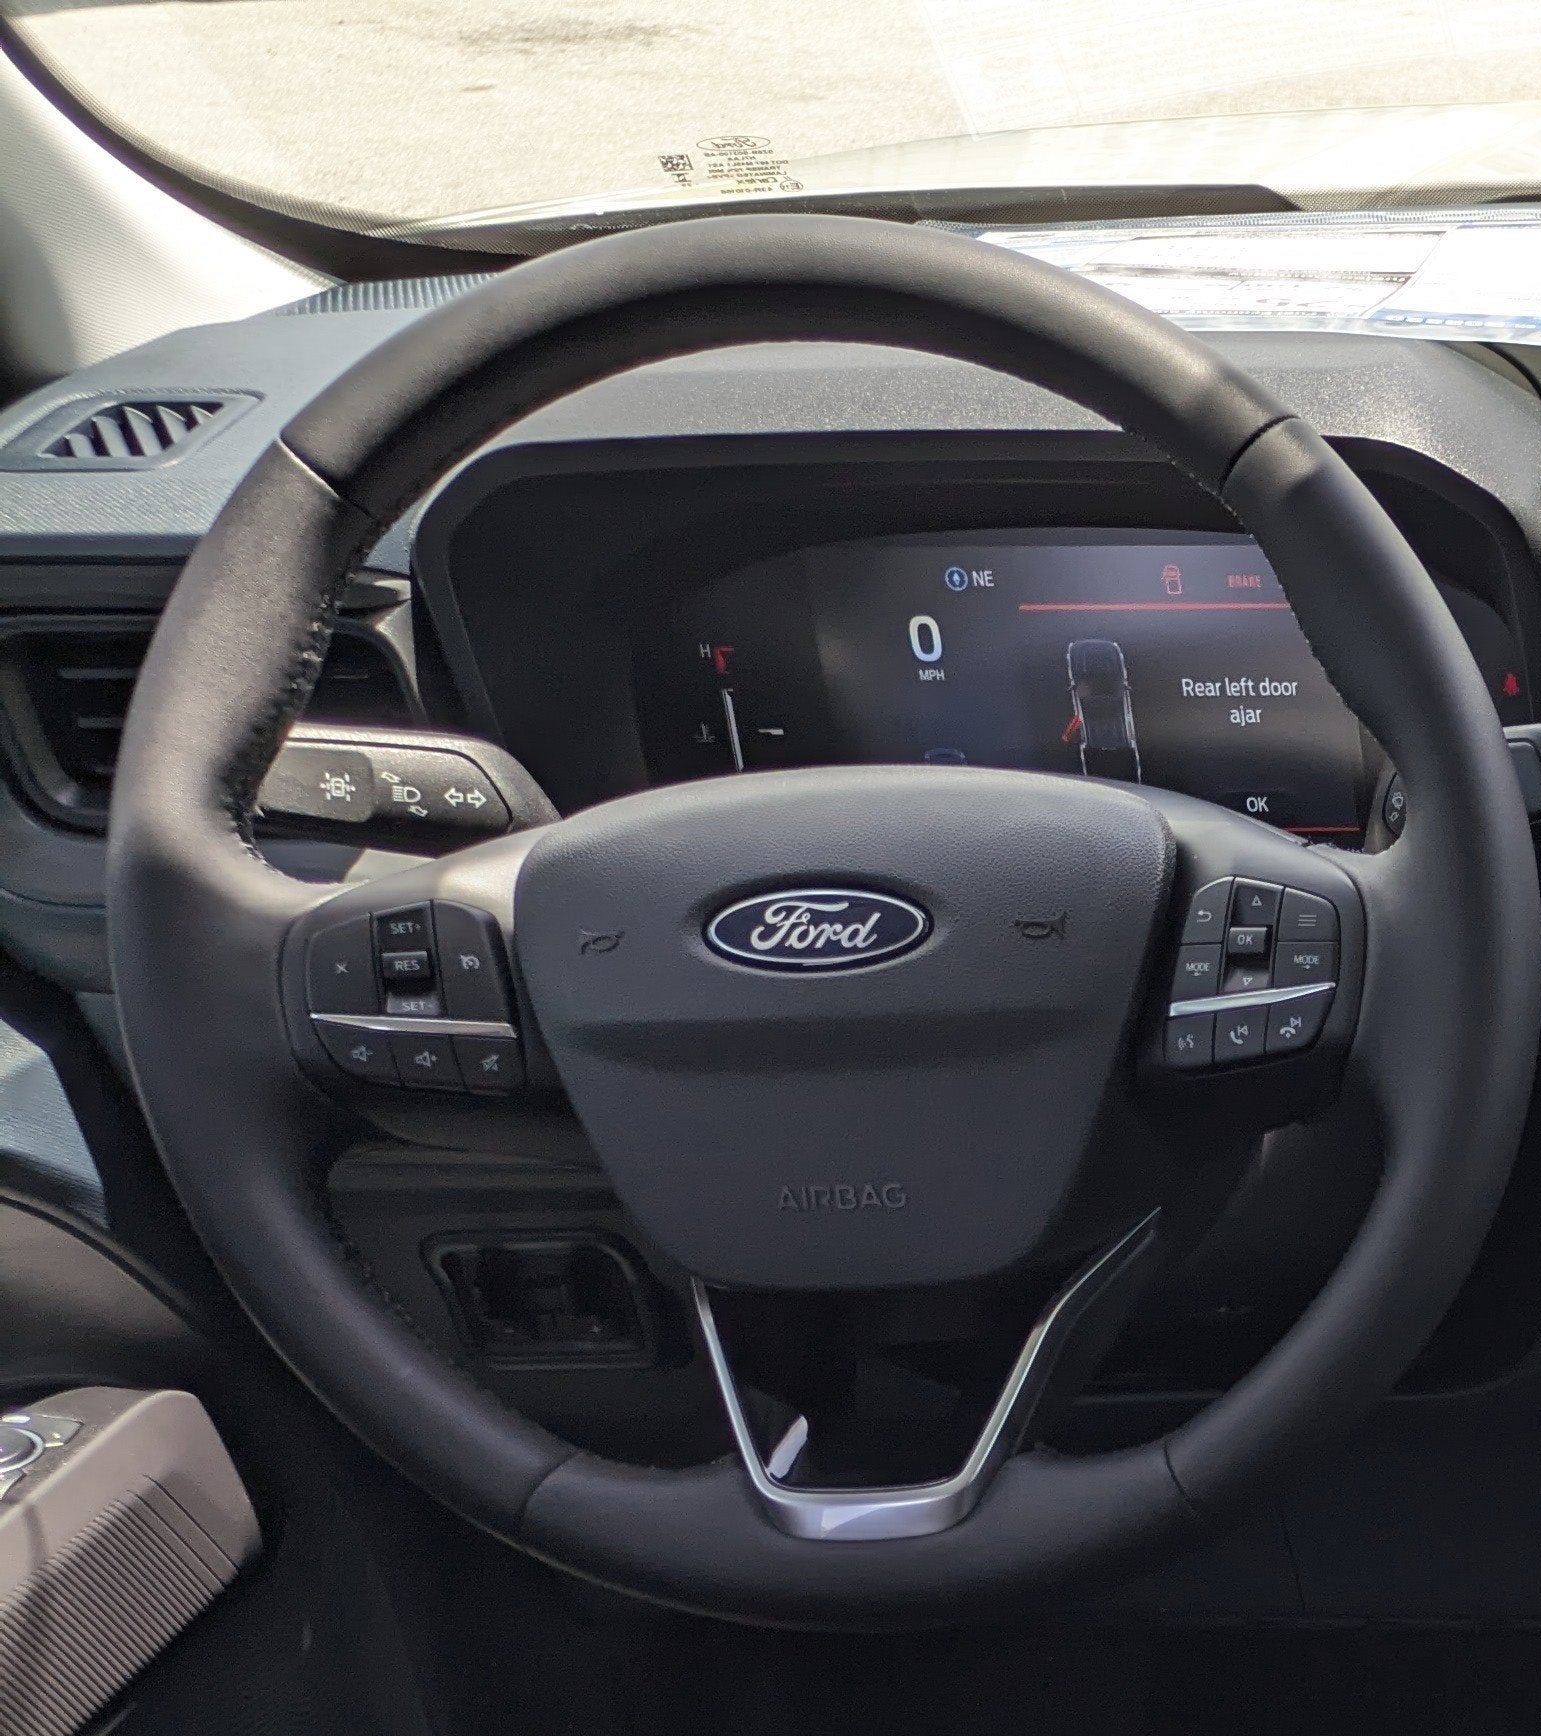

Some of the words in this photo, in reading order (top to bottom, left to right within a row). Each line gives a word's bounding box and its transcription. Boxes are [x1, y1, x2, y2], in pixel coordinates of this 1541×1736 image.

[972, 570, 995, 587] NE
[908, 615, 943, 662] 0
[700, 643, 711, 658] H
[919, 669, 945, 681] MPH
[1181, 678, 1222, 697] Rear
[1224, 677, 1256, 697] left
[1259, 677, 1298, 696] door
[1230, 705, 1262, 727] ajar
[1246, 796, 1269, 813] OK
[751, 901, 882, 951] Ford
[1237, 933, 1254, 946] OK
[394, 959, 421, 972] RES
[1185, 962, 1211, 972] MODE
[1293, 954, 1320, 966] MODE
[780, 1183, 907, 1209] AIRBAG
